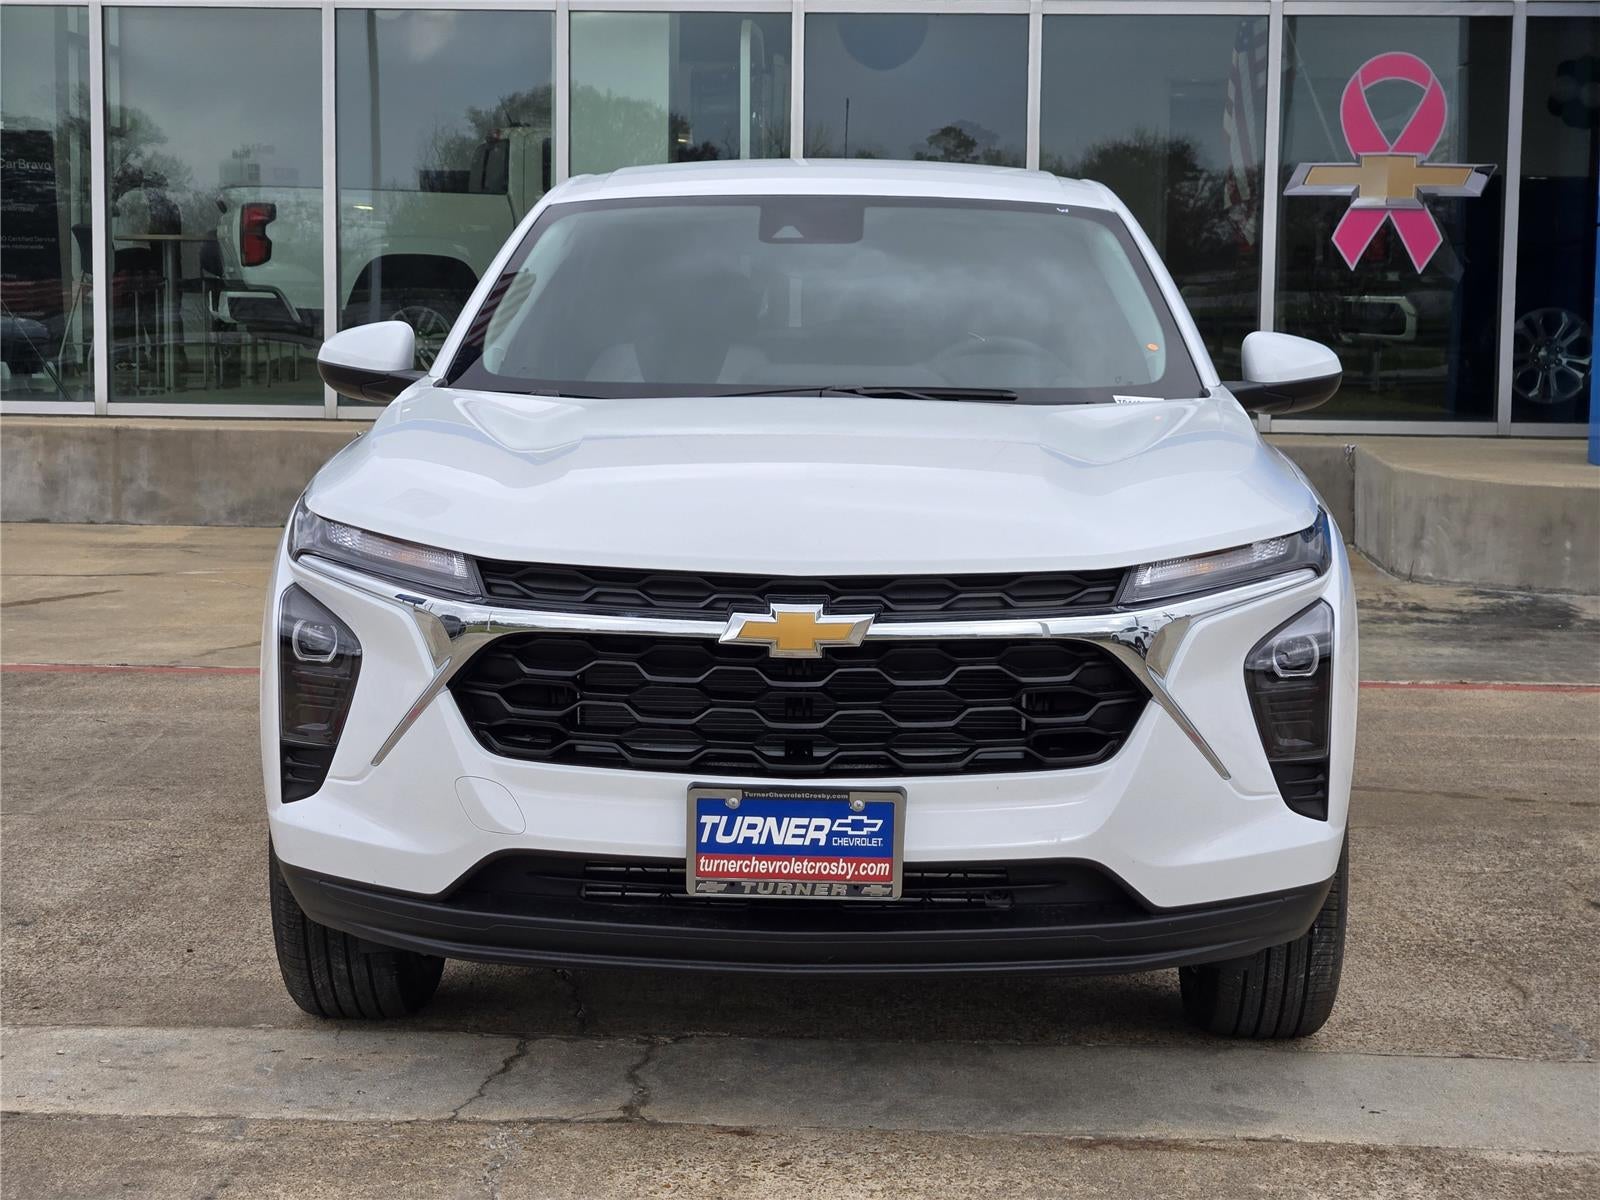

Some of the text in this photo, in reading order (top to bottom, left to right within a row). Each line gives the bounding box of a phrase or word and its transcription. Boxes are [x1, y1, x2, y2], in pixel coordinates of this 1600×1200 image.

[0, 158, 52, 170] CarBravo
[744, 791, 849, 799] TurnerChevroletCrosby.com
[700, 815, 832, 846] TURNER
[832, 837, 884, 847] CHEVROLET
[699, 856, 890, 880] turnerchevroletcrosby.com
[741, 881, 848, 896] TURNER
